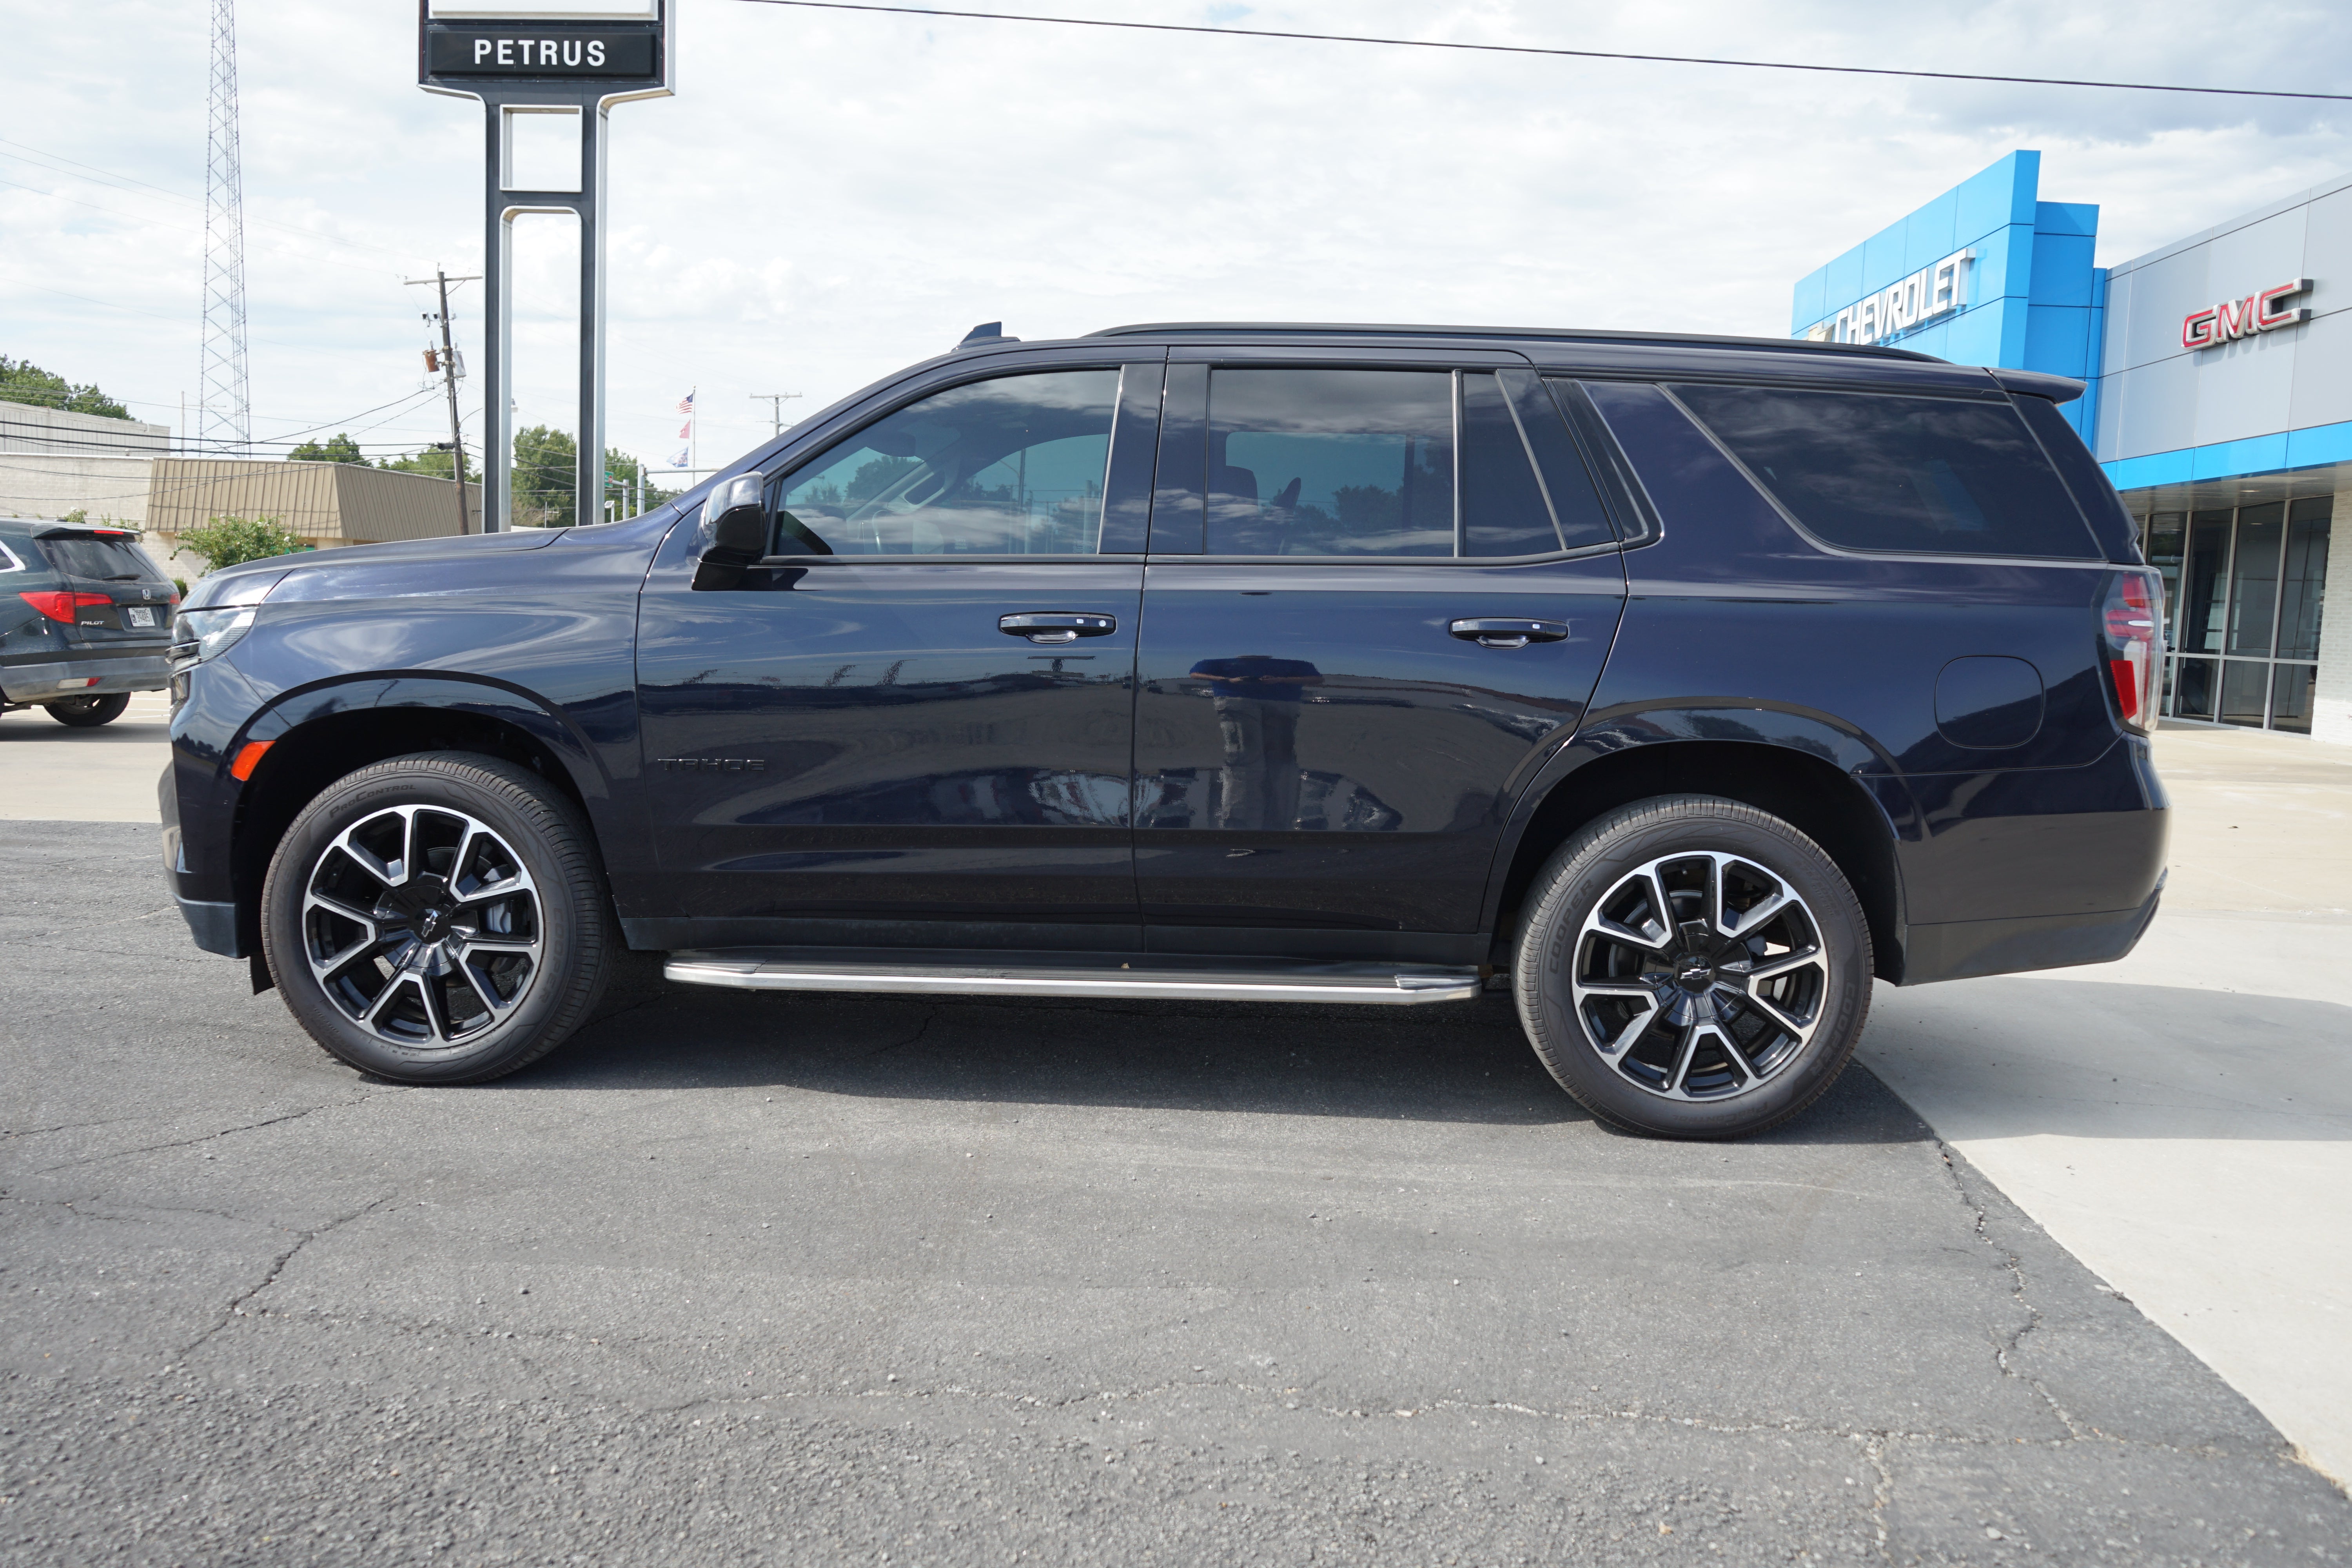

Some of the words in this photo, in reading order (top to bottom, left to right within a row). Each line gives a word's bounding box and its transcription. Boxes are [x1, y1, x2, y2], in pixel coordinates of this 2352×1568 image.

[474, 39, 605, 66] PETRUS
[1835, 248, 1969, 345] CHEVROLET
[2181, 278, 2304, 351] GMC
[657, 759, 765, 771] TAHOE
[539, 907, 564, 1003] COOPER
[1549, 879, 1594, 974] COOPER
[1809, 982, 1855, 1076] COOPER
